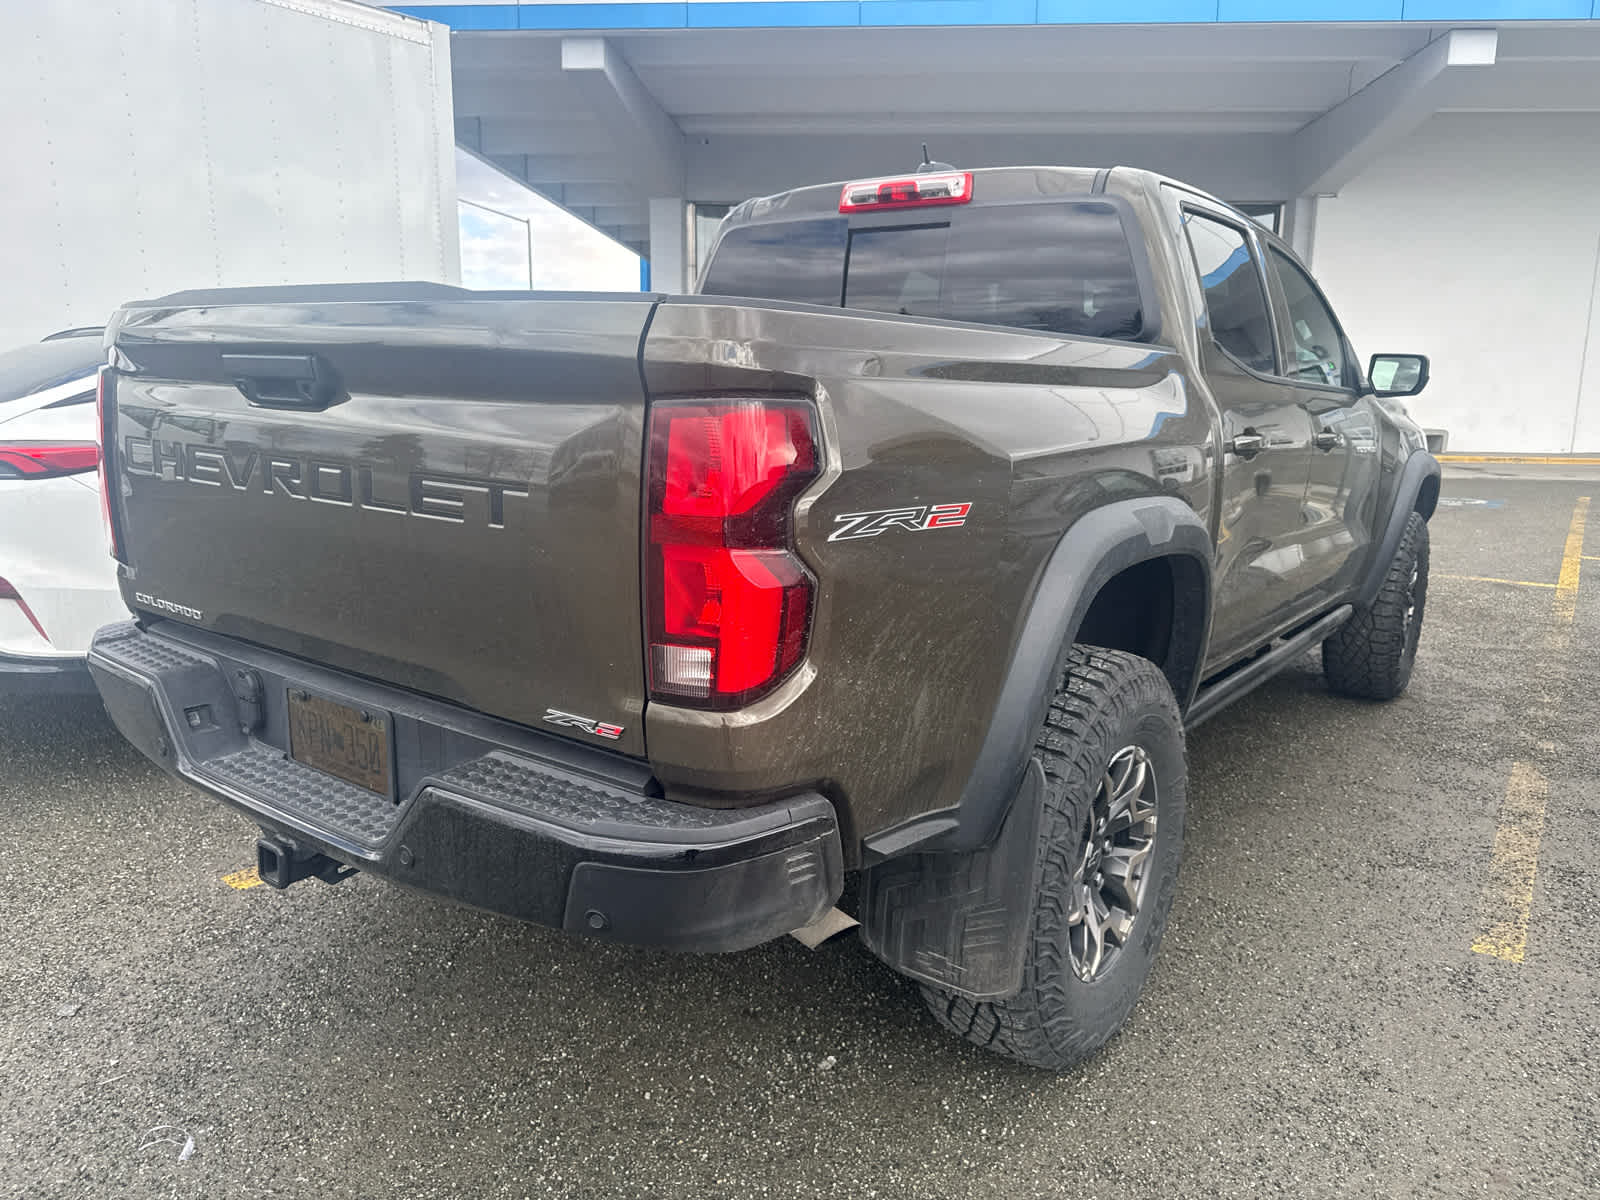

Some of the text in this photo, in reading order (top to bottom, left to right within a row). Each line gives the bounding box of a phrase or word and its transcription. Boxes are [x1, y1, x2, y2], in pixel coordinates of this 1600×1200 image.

[124, 434, 530, 529] CHEVROLET
[827, 502, 973, 542] ZR2
[135, 592, 203, 620] COLORADO
[542, 708, 625, 740] ZR2
